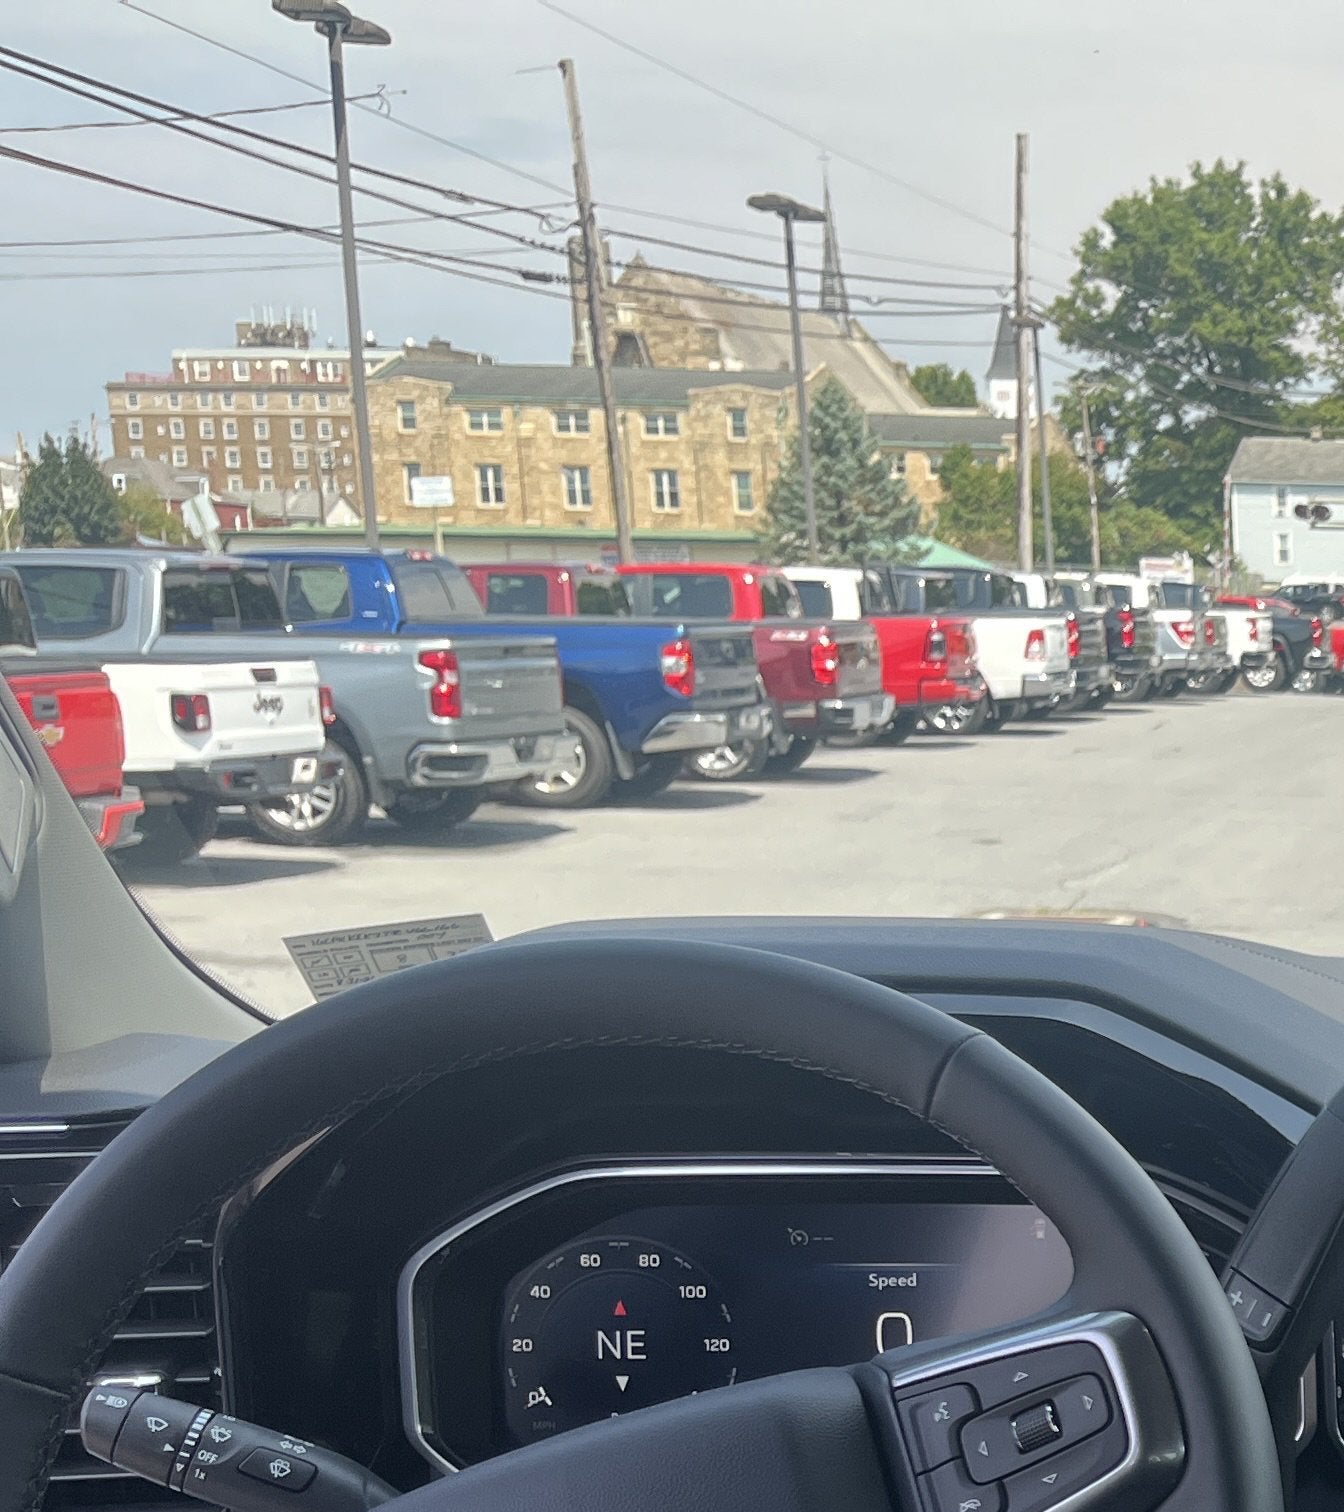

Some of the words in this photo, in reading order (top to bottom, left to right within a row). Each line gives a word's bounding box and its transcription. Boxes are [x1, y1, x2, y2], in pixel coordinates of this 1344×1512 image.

[579, 1254, 601, 1267] 60
[638, 1254, 660, 1267] 80
[868, 1272, 917, 1291] Speed
[530, 1285, 551, 1298] 40
[679, 1285, 707, 1298] 100
[512, 1338, 533, 1352] 20
[597, 1330, 647, 1360] NE
[703, 1338, 730, 1352] 120
[198, 1450, 218, 1464] OFF
